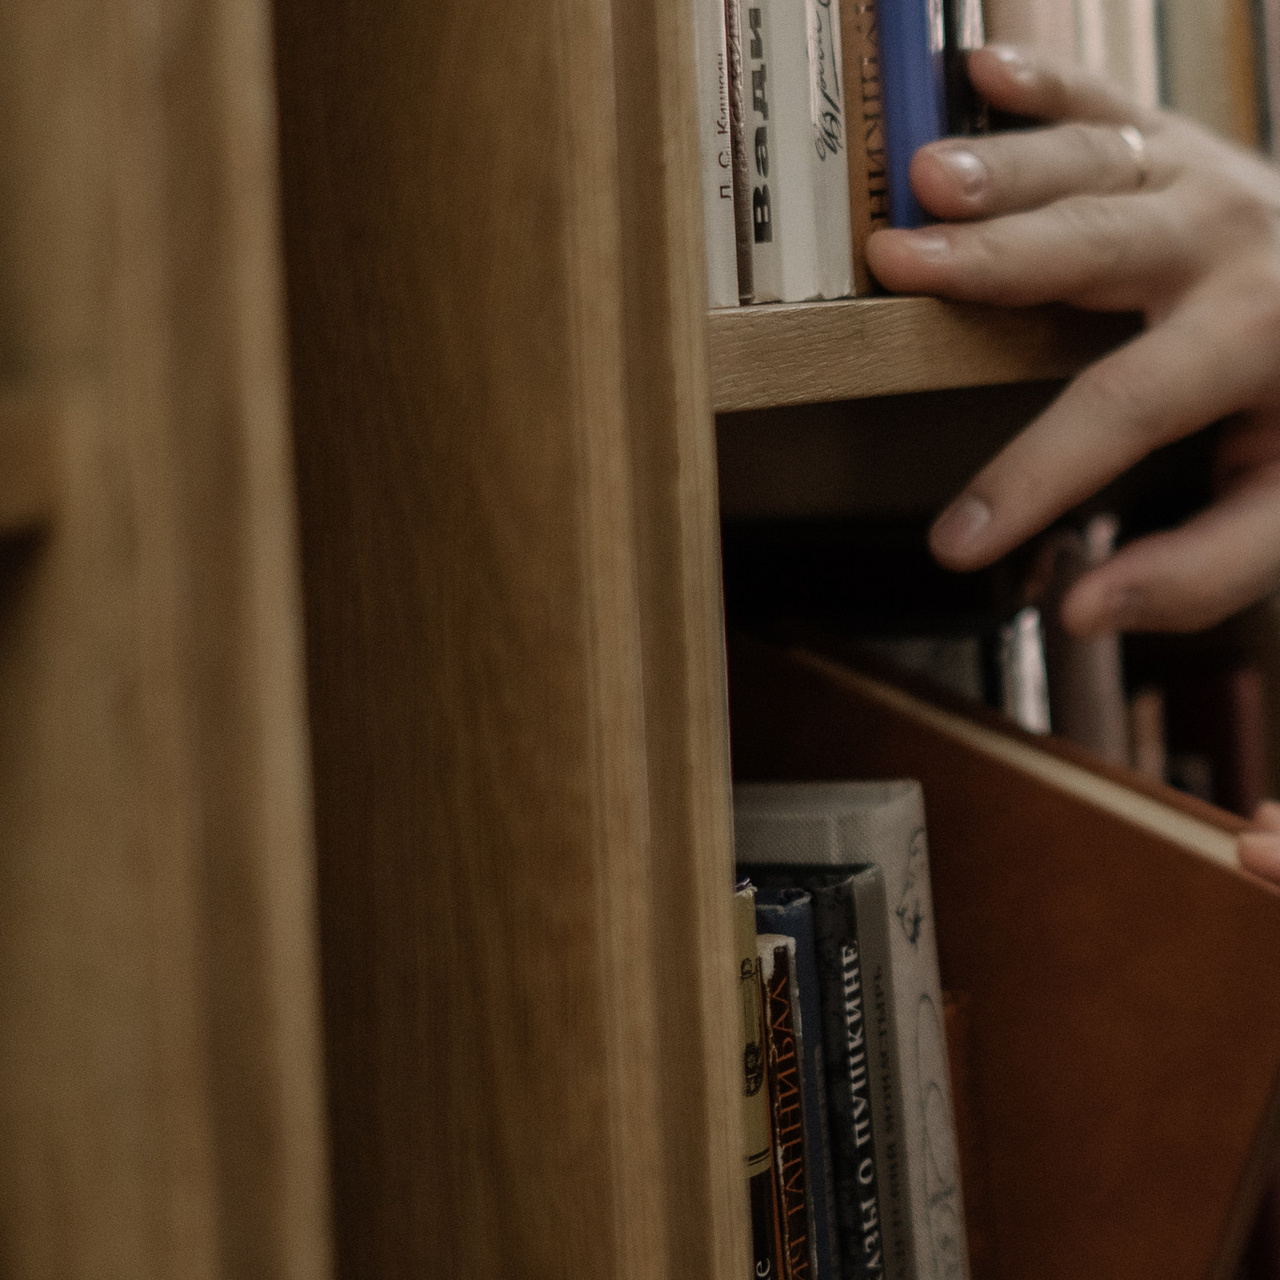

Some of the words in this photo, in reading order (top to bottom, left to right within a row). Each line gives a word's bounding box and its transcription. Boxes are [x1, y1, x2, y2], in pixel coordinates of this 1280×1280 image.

[769, 975, 807, 1218] ГАННИБАЛ
[841, 938, 873, 1150] ПУШКИНЕ
[857, 1156, 875, 1186] О
